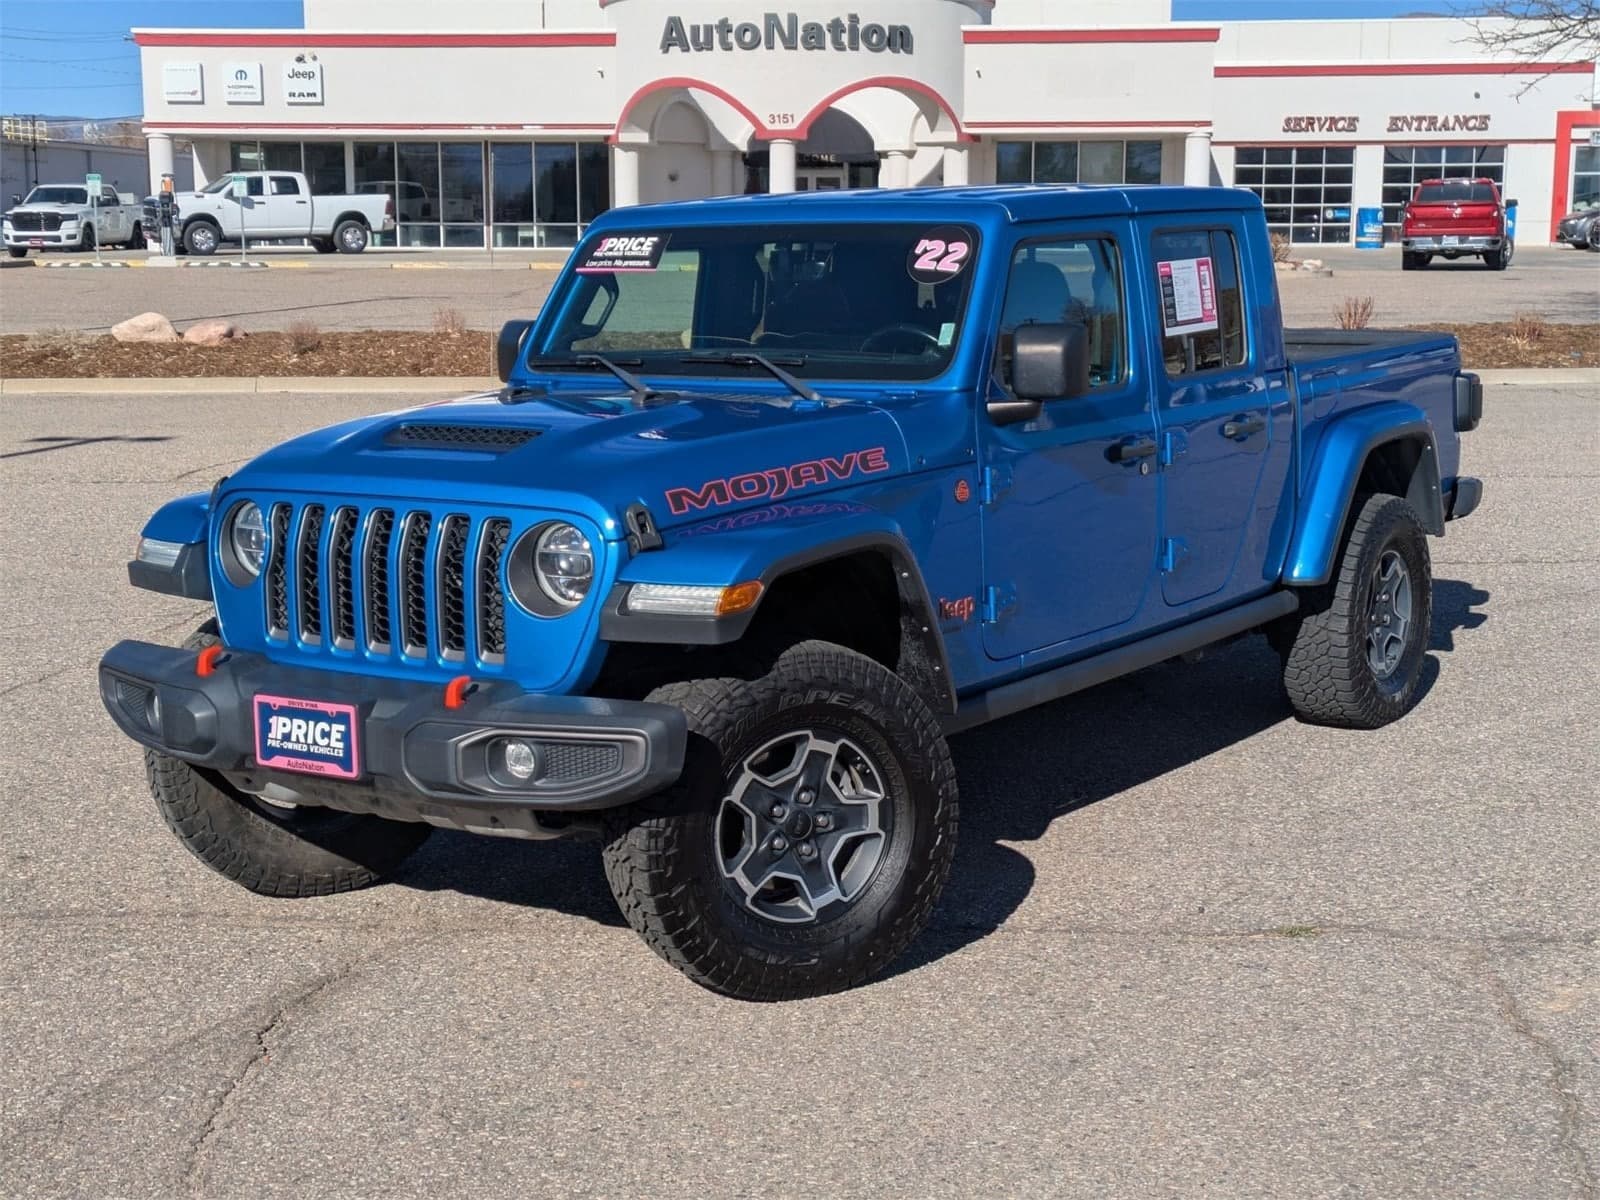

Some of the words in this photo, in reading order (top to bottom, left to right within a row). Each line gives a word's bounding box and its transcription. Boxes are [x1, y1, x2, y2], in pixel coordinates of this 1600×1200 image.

[659, 12, 914, 54] AutoNation
[287, 68, 315, 80] Jeep
[768, 113, 796, 124] 3151
[1282, 116, 1359, 132] SERVICE
[1387, 115, 1491, 132] ENTRANCE
[914, 239, 968, 272] '22
[665, 447, 889, 515] MOJAVE
[268, 715, 345, 748] 1PRICE
[267, 739, 308, 753] PRE-OWNED
[309, 744, 345, 757] VEHICLES
[286, 760, 325, 772] AutoNation
